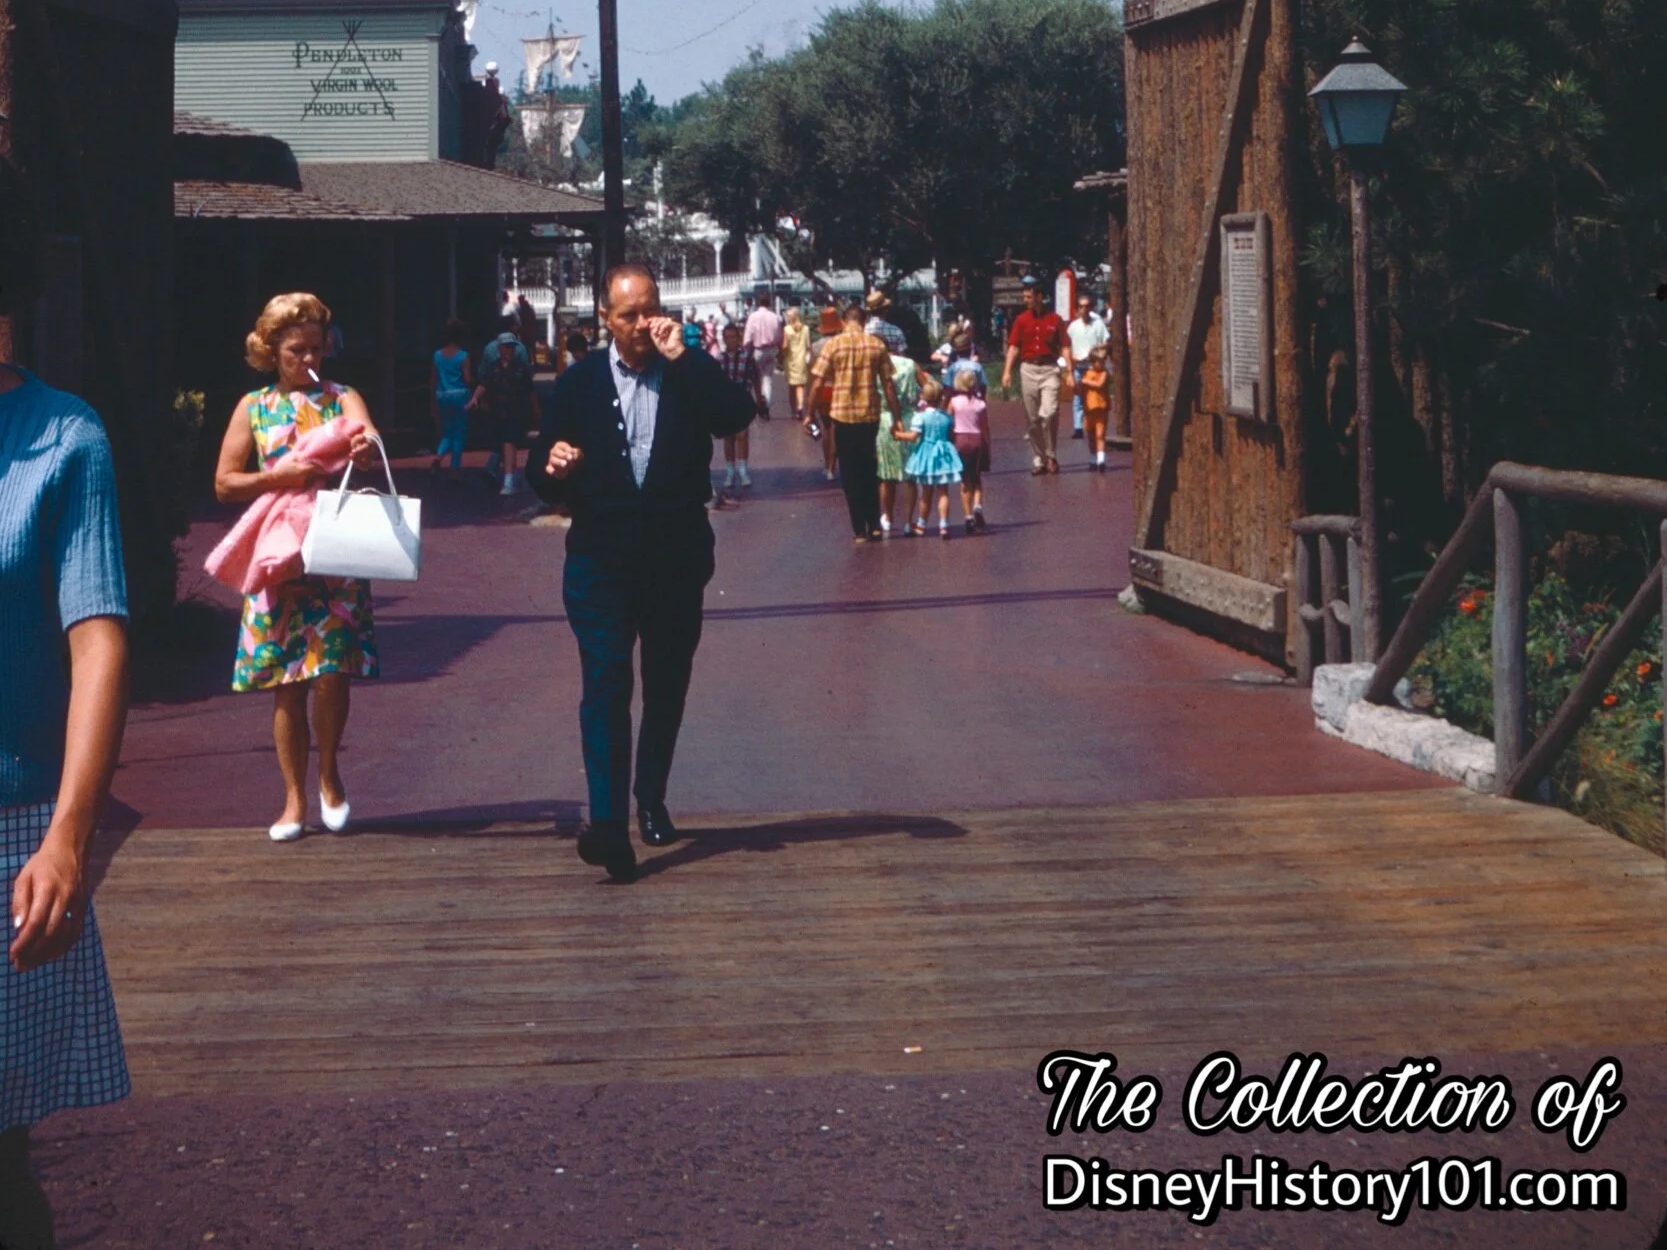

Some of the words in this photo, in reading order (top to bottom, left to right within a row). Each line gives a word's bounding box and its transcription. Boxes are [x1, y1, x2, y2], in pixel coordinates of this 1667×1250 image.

[292, 42, 403, 68] PENDLETON
[310, 78, 357, 93] VIRGIN
[363, 78, 399, 92] WOOL
[304, 102, 395, 117] PRODUCTS
